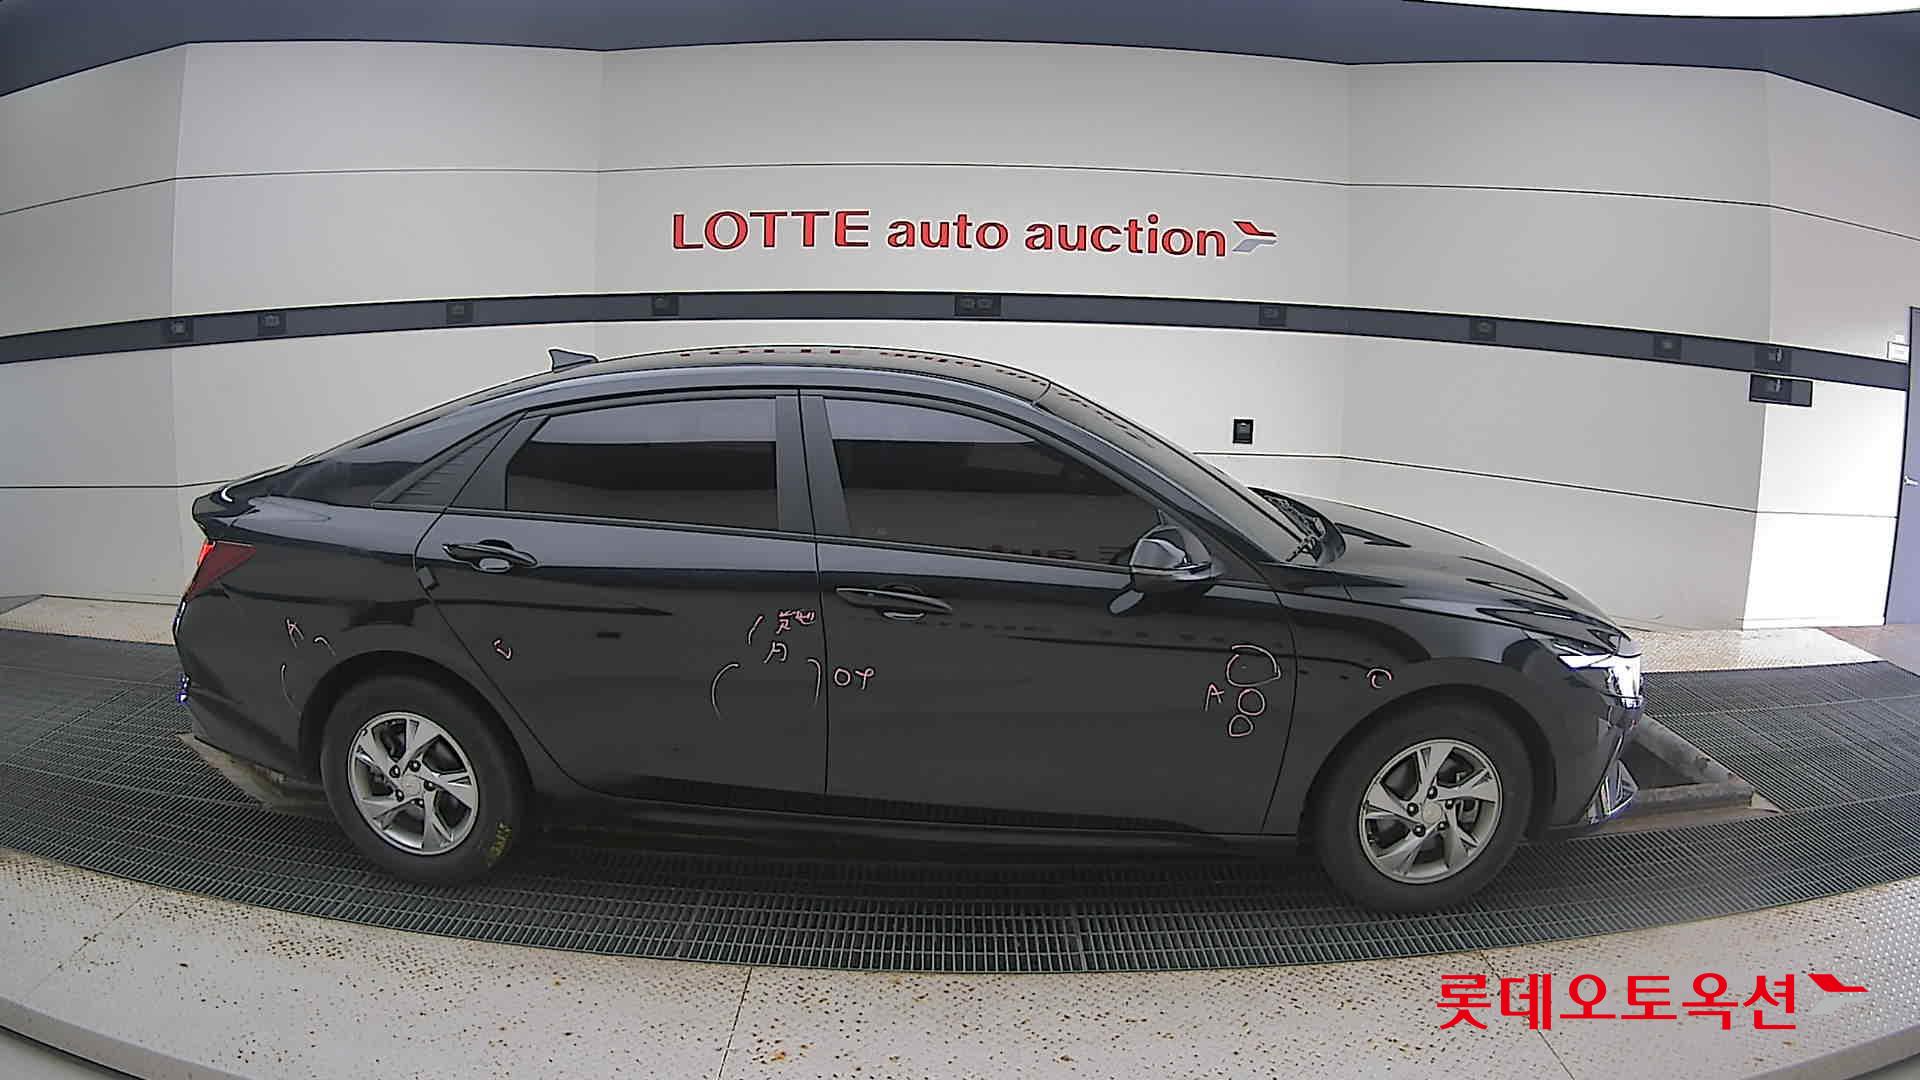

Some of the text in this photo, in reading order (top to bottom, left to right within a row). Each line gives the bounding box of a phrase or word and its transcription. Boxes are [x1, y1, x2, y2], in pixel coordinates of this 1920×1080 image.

[672, 209, 1227, 258] LOTTE auto auction
